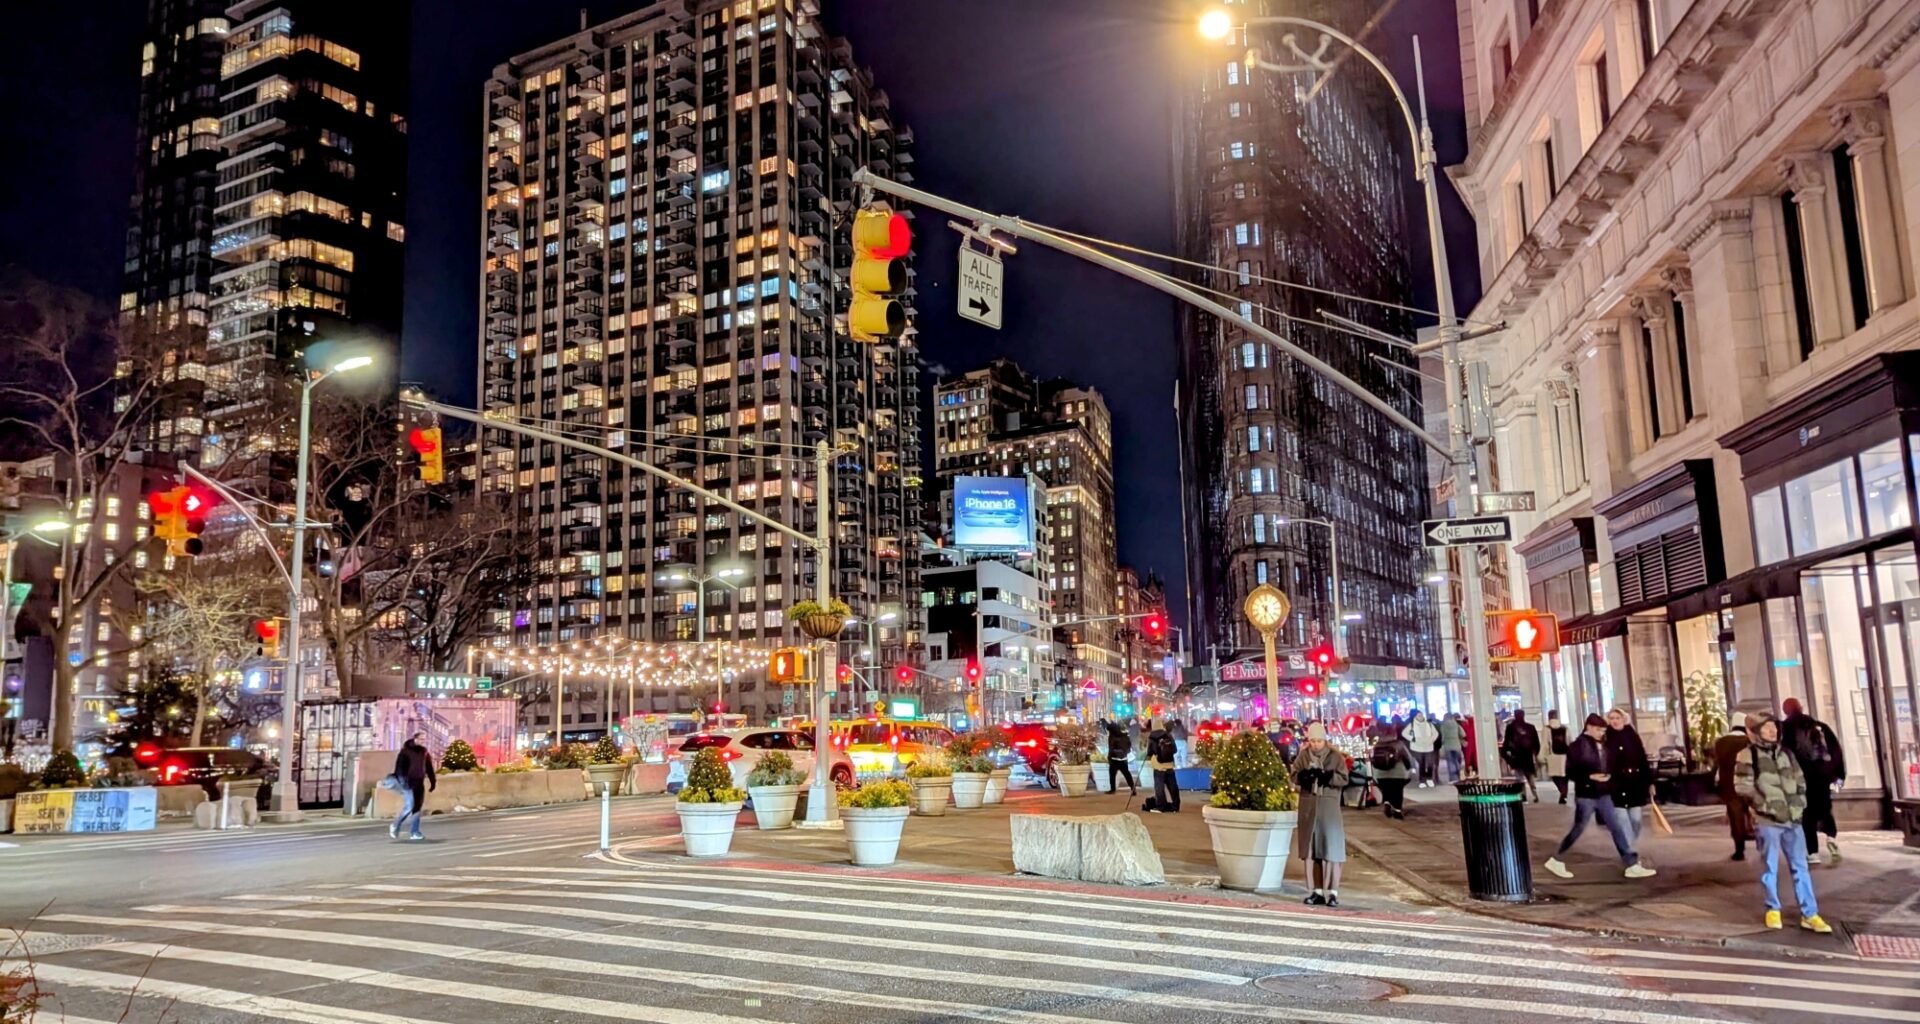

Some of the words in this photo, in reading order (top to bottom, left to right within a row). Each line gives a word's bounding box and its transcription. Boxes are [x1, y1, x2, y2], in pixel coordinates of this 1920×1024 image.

[970, 258, 992, 280] ALL
[963, 274, 999, 299] TRAFFIC
[965, 498, 1002, 509] iPhone
[1003, 499, 1015, 509] 16
[1499, 497, 1512, 510] 24
[1519, 496, 1531, 510] St
[1437, 527, 1461, 539] ONE
[1472, 524, 1499, 536] WAY
[1571, 625, 1602, 644] EATALY
[417, 676, 472, 690] EATALY
